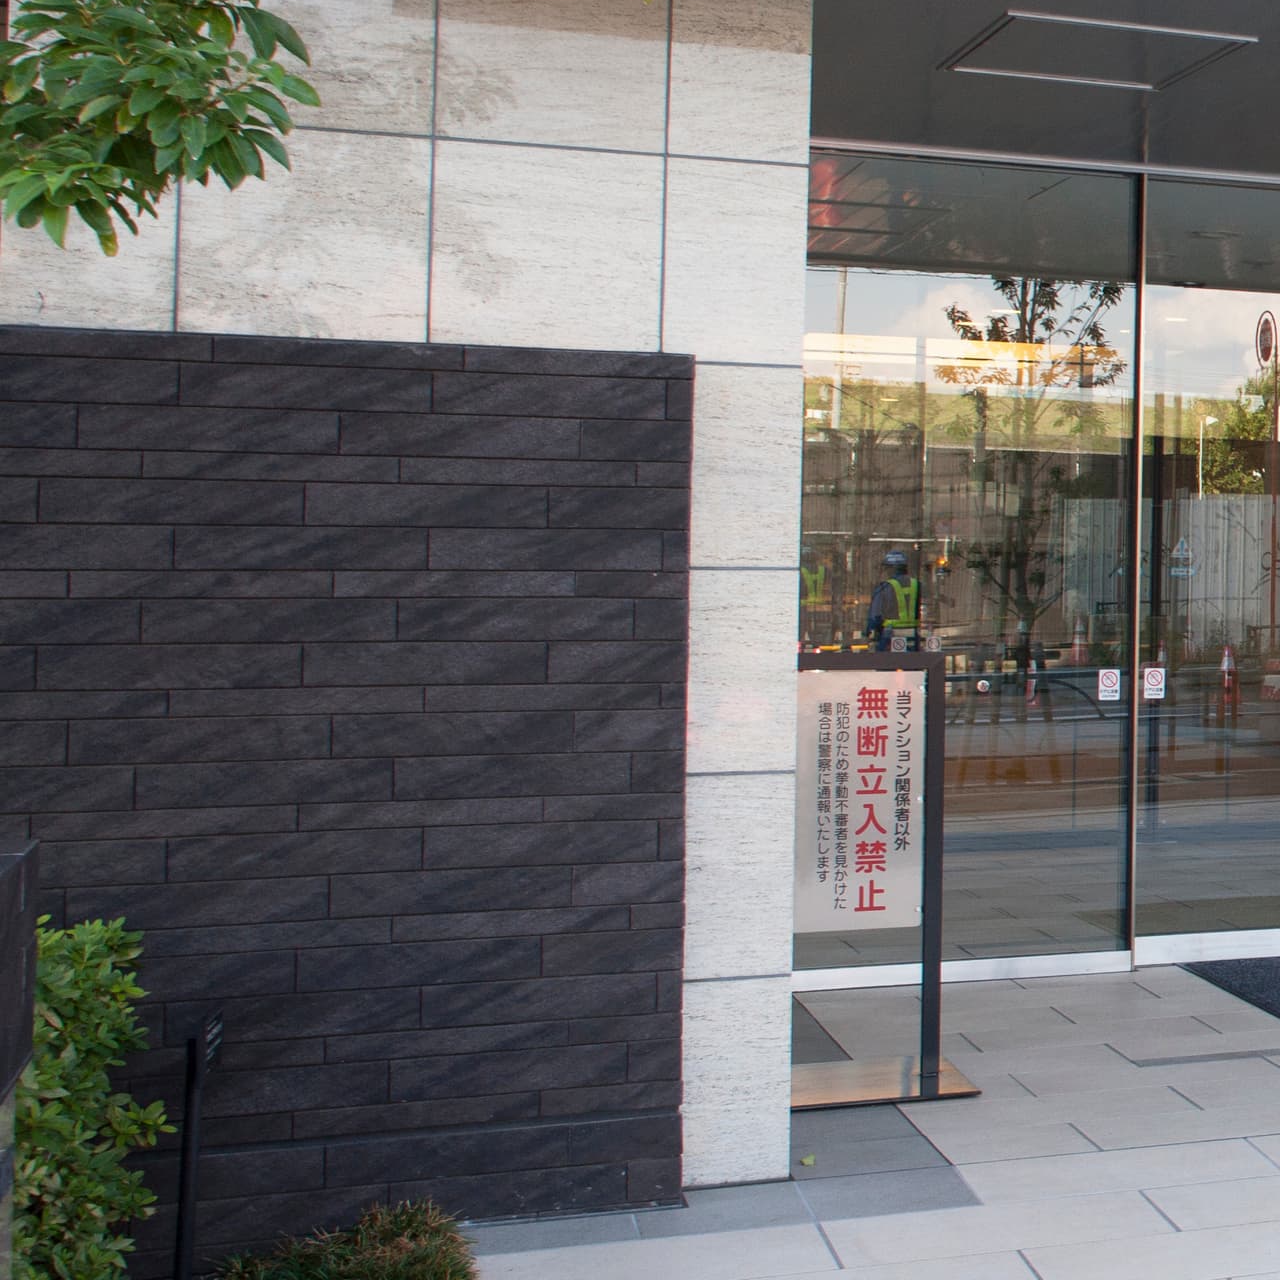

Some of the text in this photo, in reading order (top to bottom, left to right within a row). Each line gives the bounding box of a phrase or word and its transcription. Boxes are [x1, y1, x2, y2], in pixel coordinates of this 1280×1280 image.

[854, 687, 888, 912] 無断立入禁止
[894, 690, 911, 852] 当マンション関係者以外
